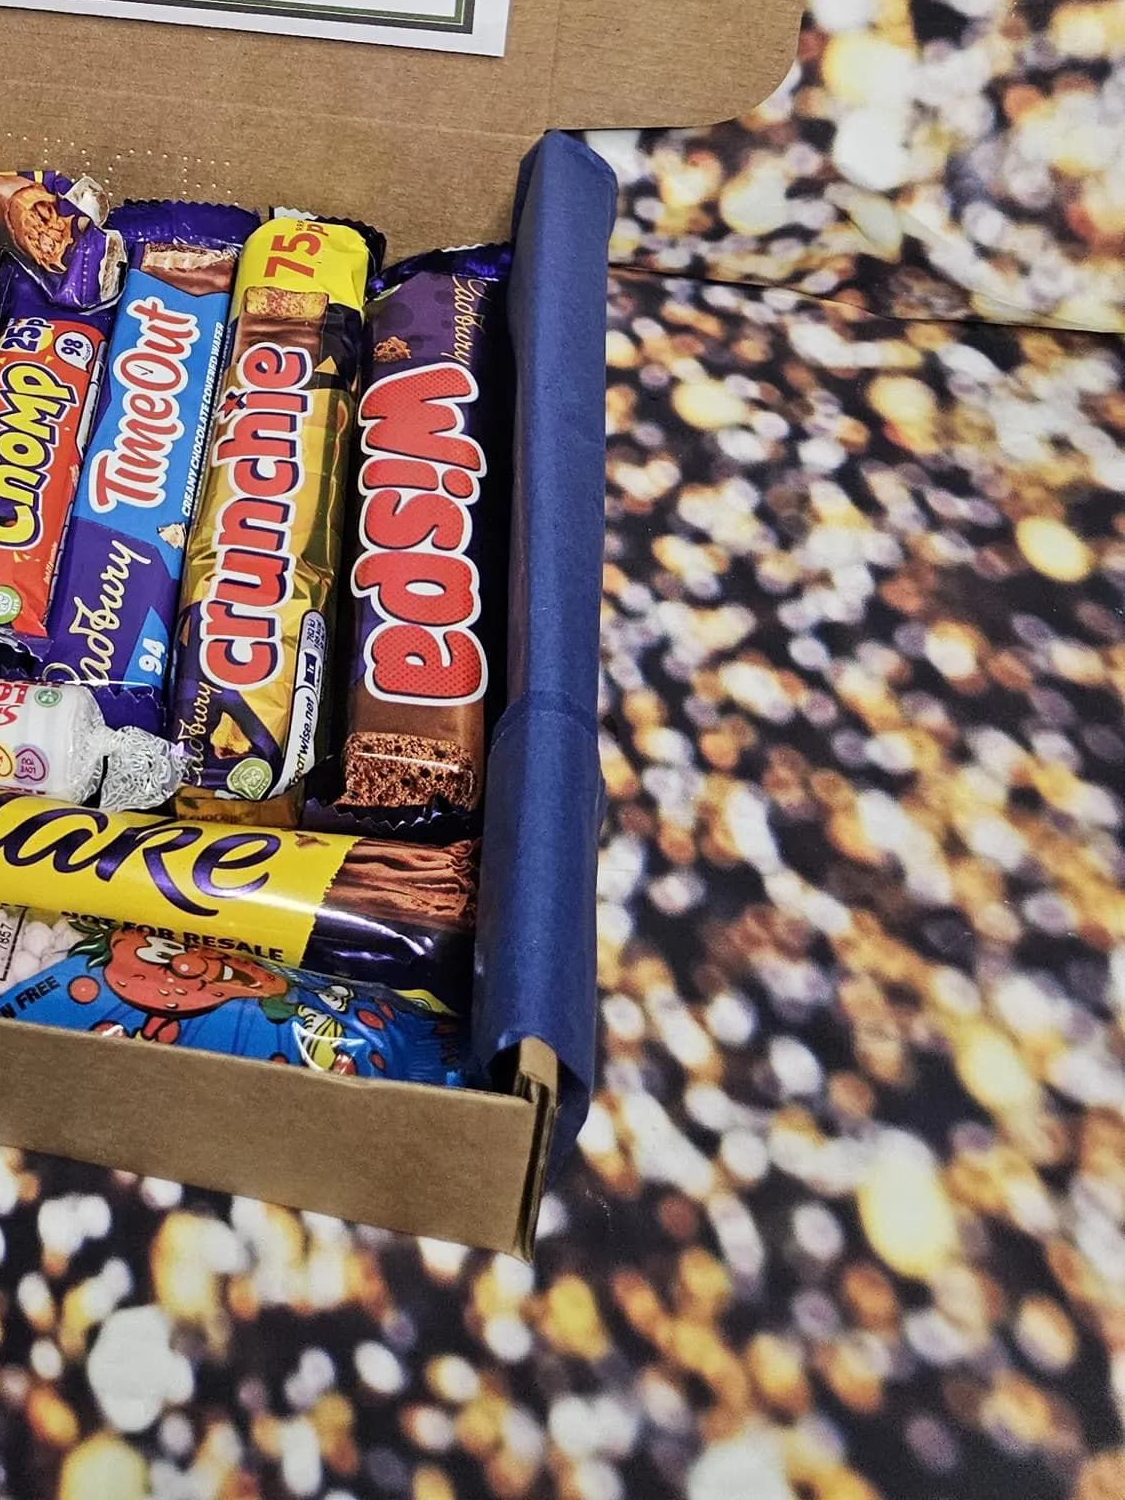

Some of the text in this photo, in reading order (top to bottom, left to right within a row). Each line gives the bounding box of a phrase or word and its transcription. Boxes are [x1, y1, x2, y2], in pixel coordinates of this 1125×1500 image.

[264, 224, 329, 278] 75p
[1, 317, 53, 352] 25p
[452, 278, 492, 367] Cadbury
[61, 338, 84, 357] 98
[182, 322, 225, 517] CREAMY CHOCOLATE COVERED WAFER
[138, 638, 166, 676] 94
[61, 911, 284, 962] NOT FOR RESALE
[17, 975, 61, 1014] FREE
